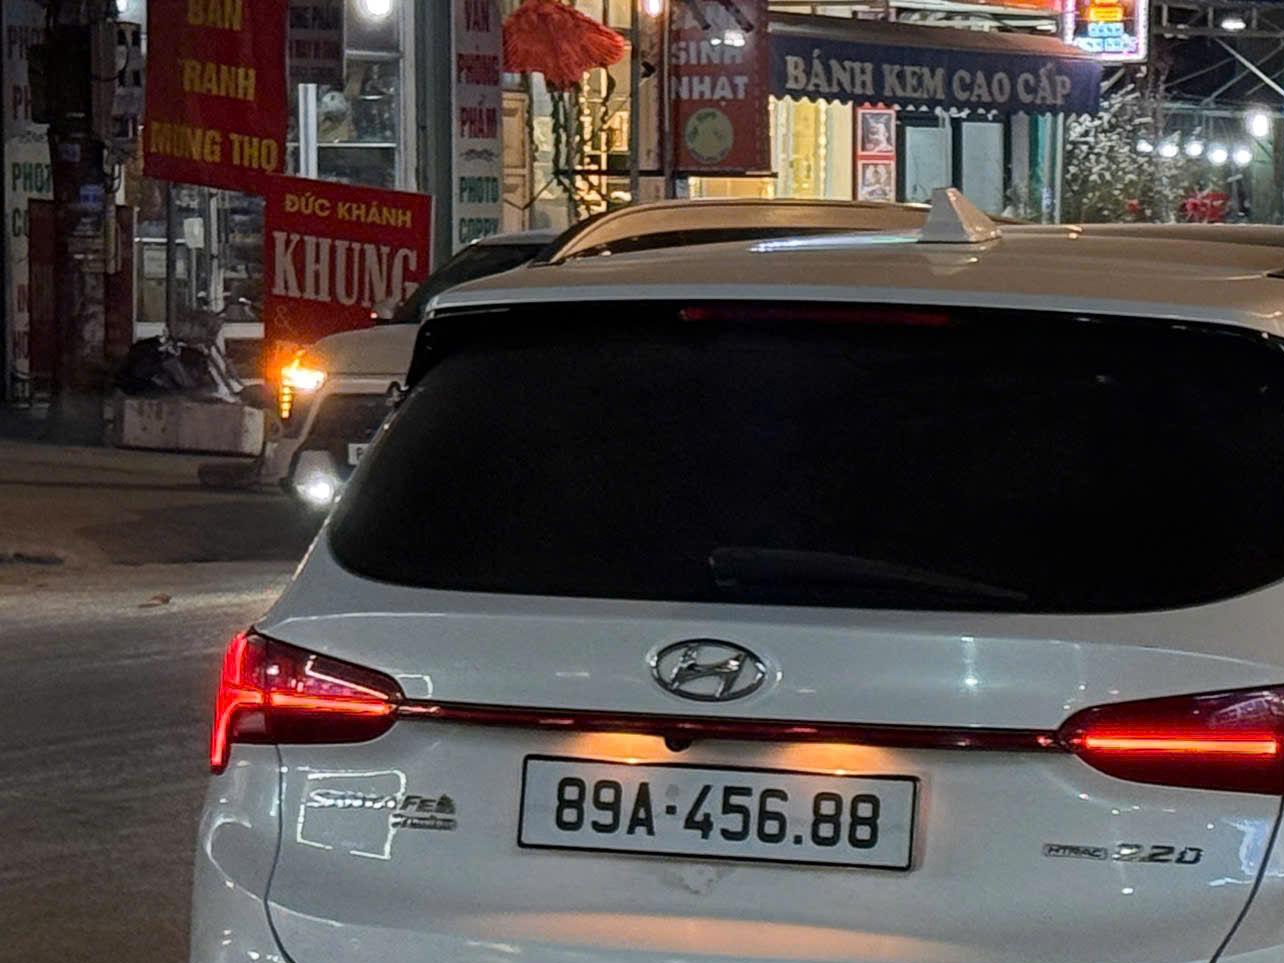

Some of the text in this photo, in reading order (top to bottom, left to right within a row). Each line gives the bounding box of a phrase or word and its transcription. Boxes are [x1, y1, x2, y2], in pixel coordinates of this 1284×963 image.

[177, 58, 257, 101] RANH
[784, 48, 1072, 105] BÁNH KEM CAO CẤP
[283, 192, 413, 229] ĐỨC KHÁNH
[458, 176, 499, 204] PHOTO
[271, 230, 420, 306] KHUNG
